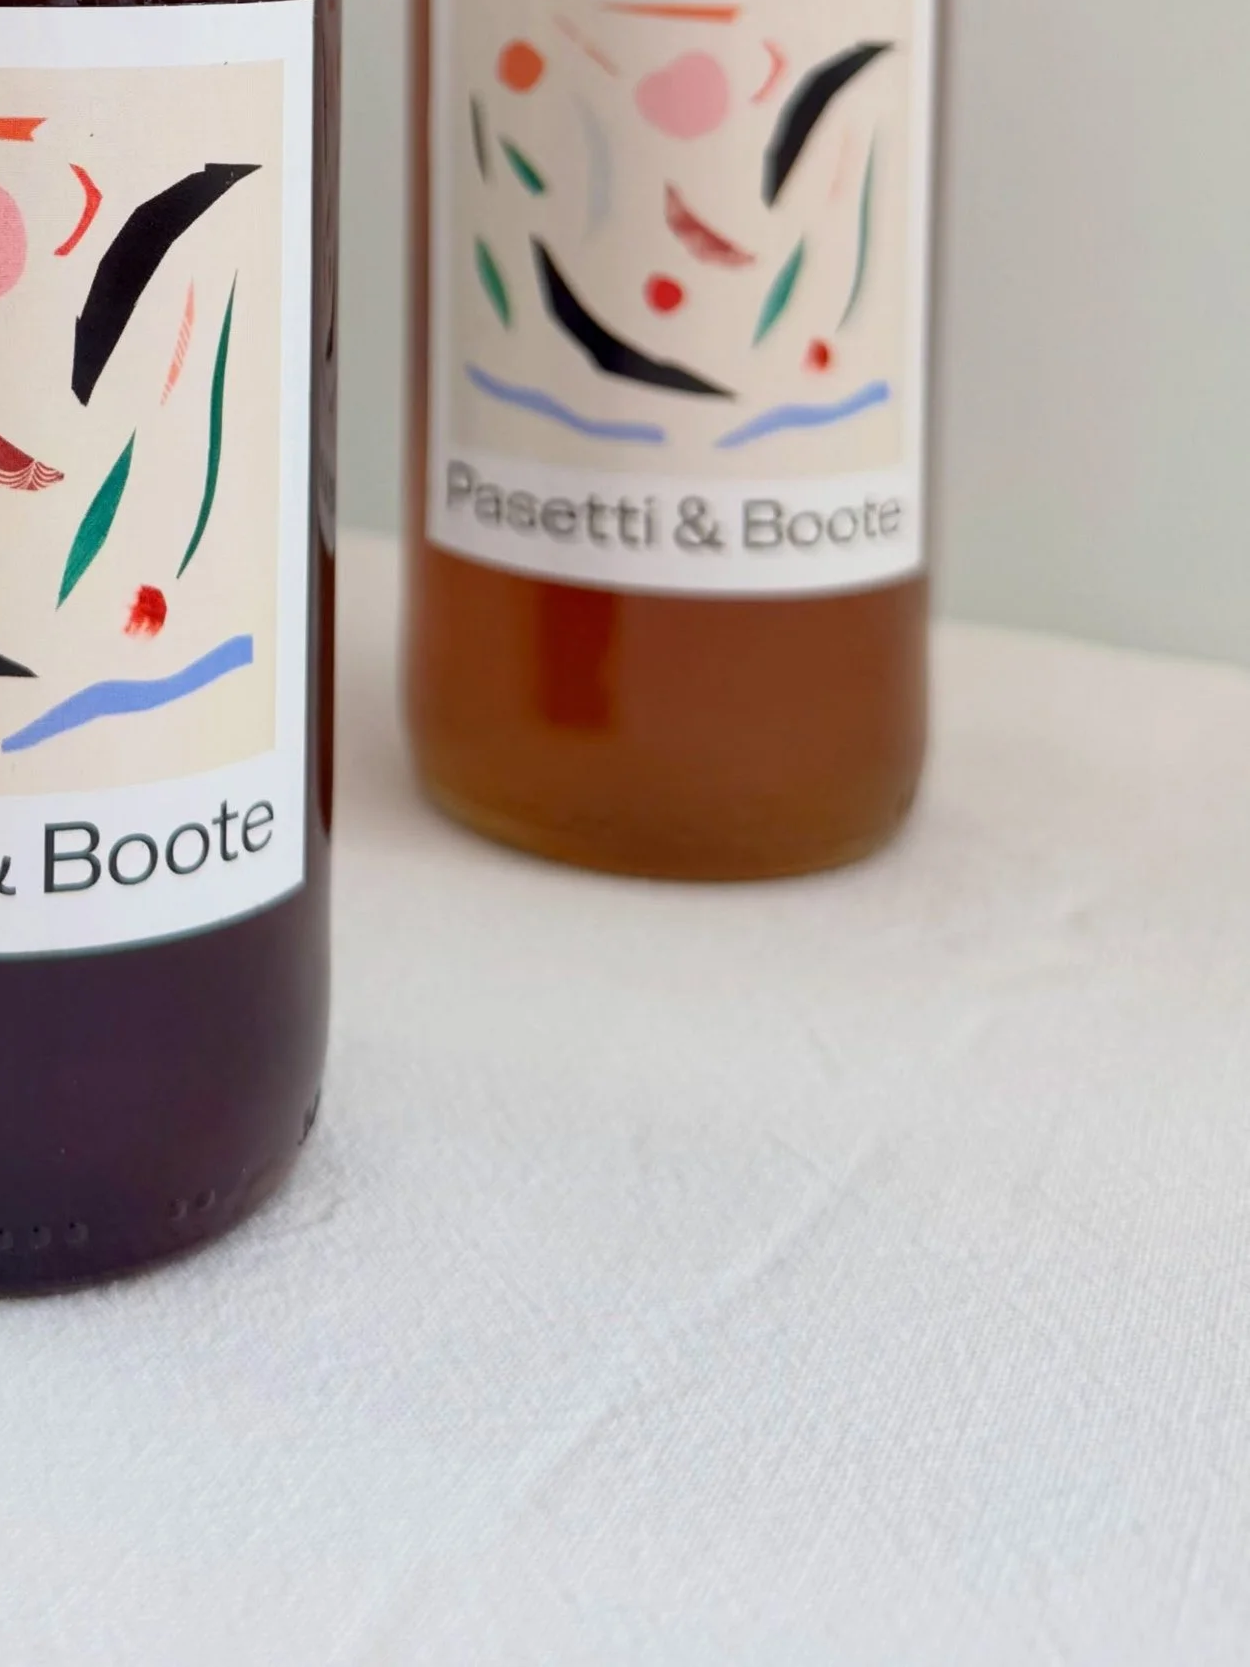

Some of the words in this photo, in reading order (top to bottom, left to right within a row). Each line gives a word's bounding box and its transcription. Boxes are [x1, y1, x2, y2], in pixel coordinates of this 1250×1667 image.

[446, 460, 656, 549] Pasetti
[672, 495, 725, 553] &
[742, 495, 903, 552] Boote
[43, 798, 276, 895] Boote
